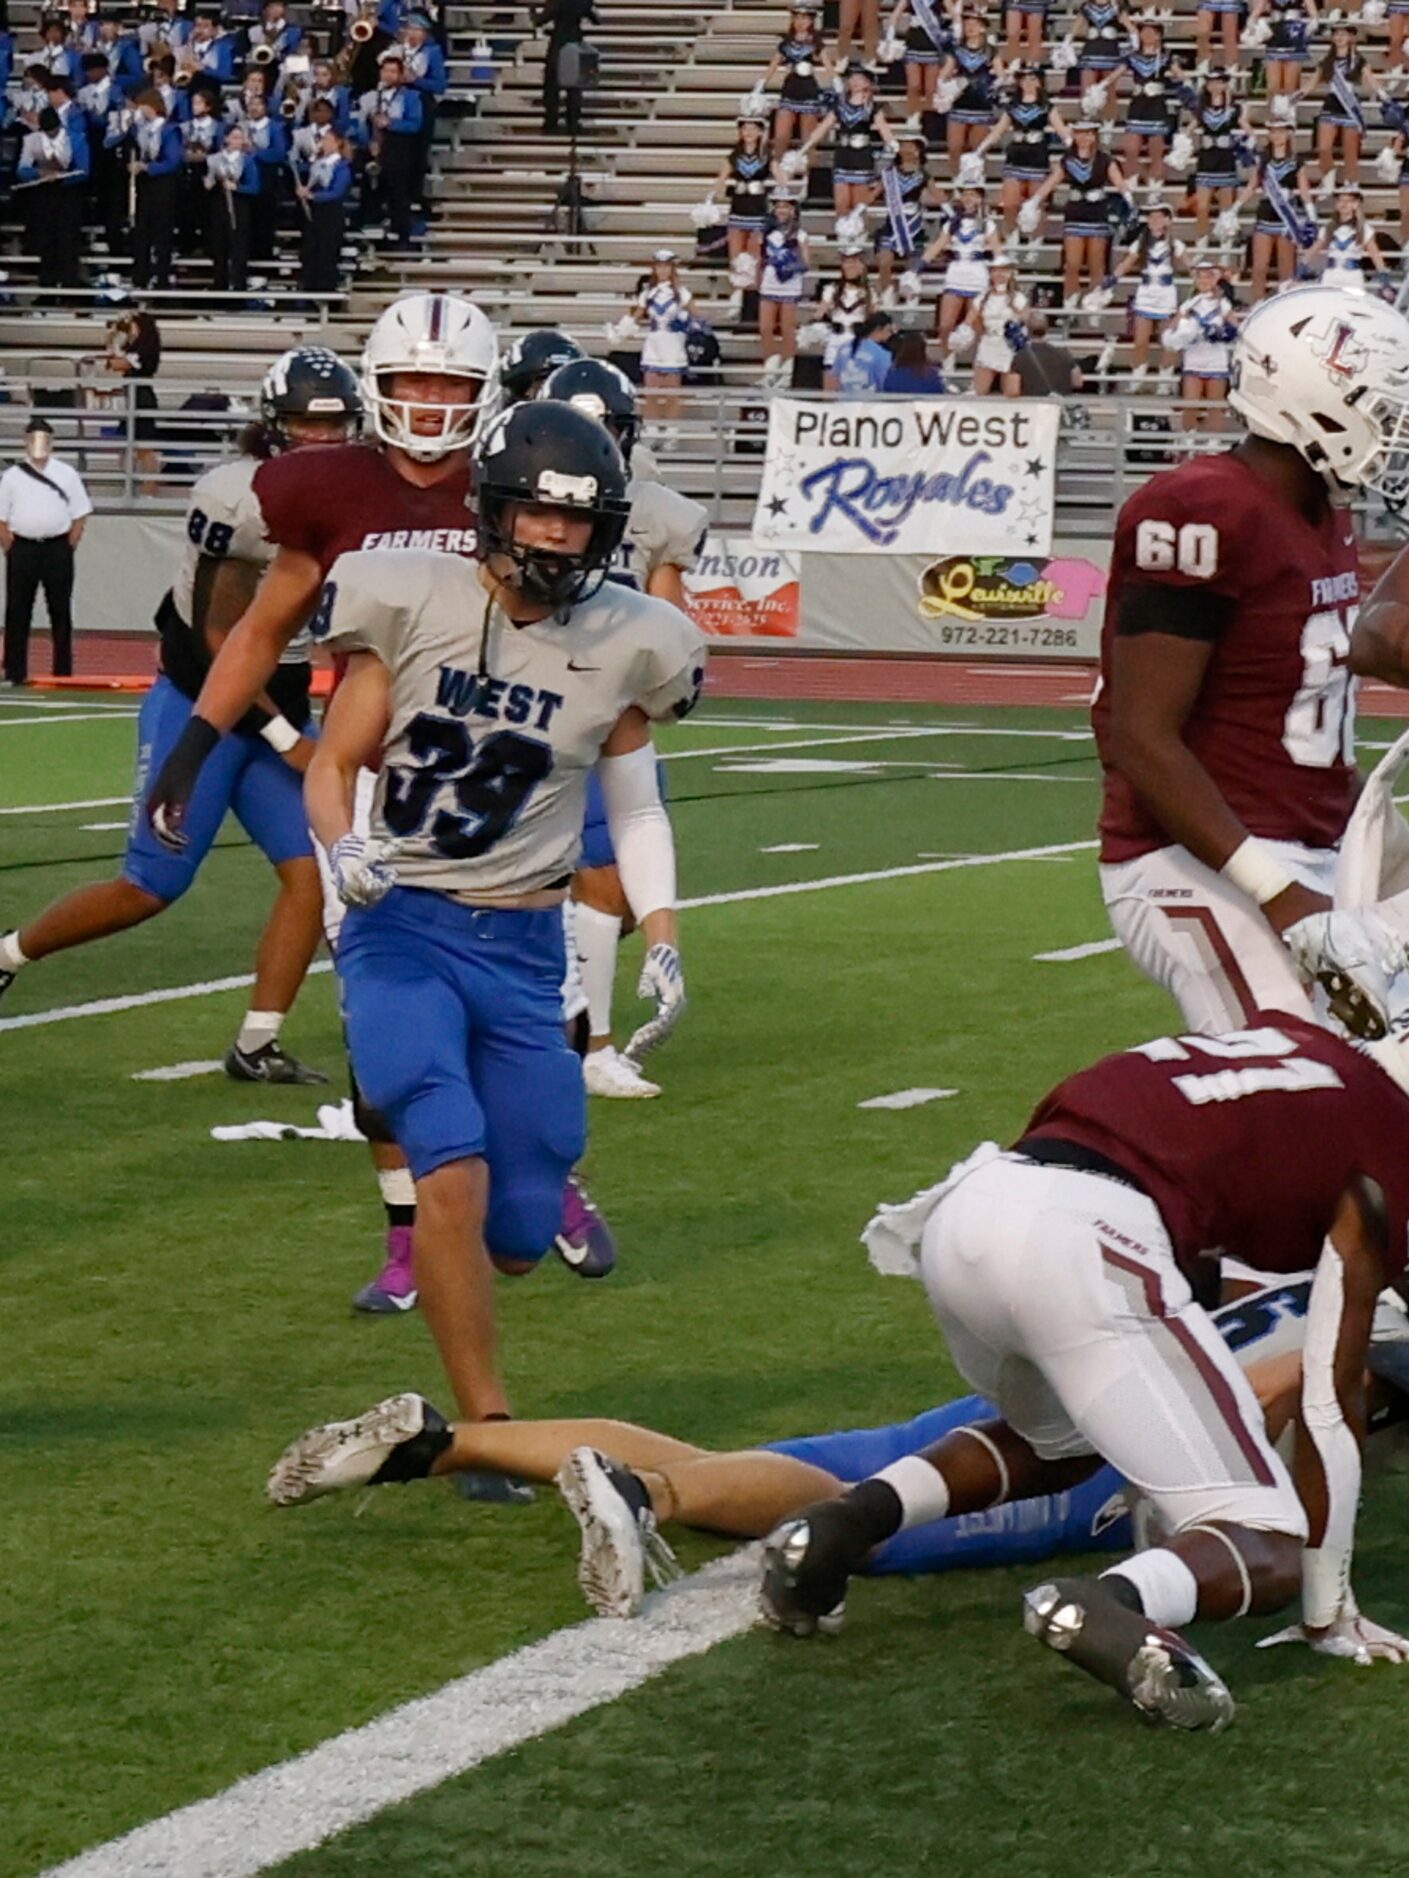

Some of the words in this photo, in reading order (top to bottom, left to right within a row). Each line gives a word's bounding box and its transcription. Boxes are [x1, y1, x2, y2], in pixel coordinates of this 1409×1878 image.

[794, 410, 902, 449] Plano
[914, 409, 1030, 449] West
[800, 449, 1015, 547] Royales
[188, 508, 234, 556] 88
[361, 528, 478, 552] FARMERS
[1136, 519, 1218, 580] 60
[687, 553, 781, 578] nson
[941, 626, 1077, 647] 972-221-7286
[434, 665, 564, 733] WEST
[384, 711, 556, 859] 39
[1092, 1218, 1150, 1256] FARMERS
